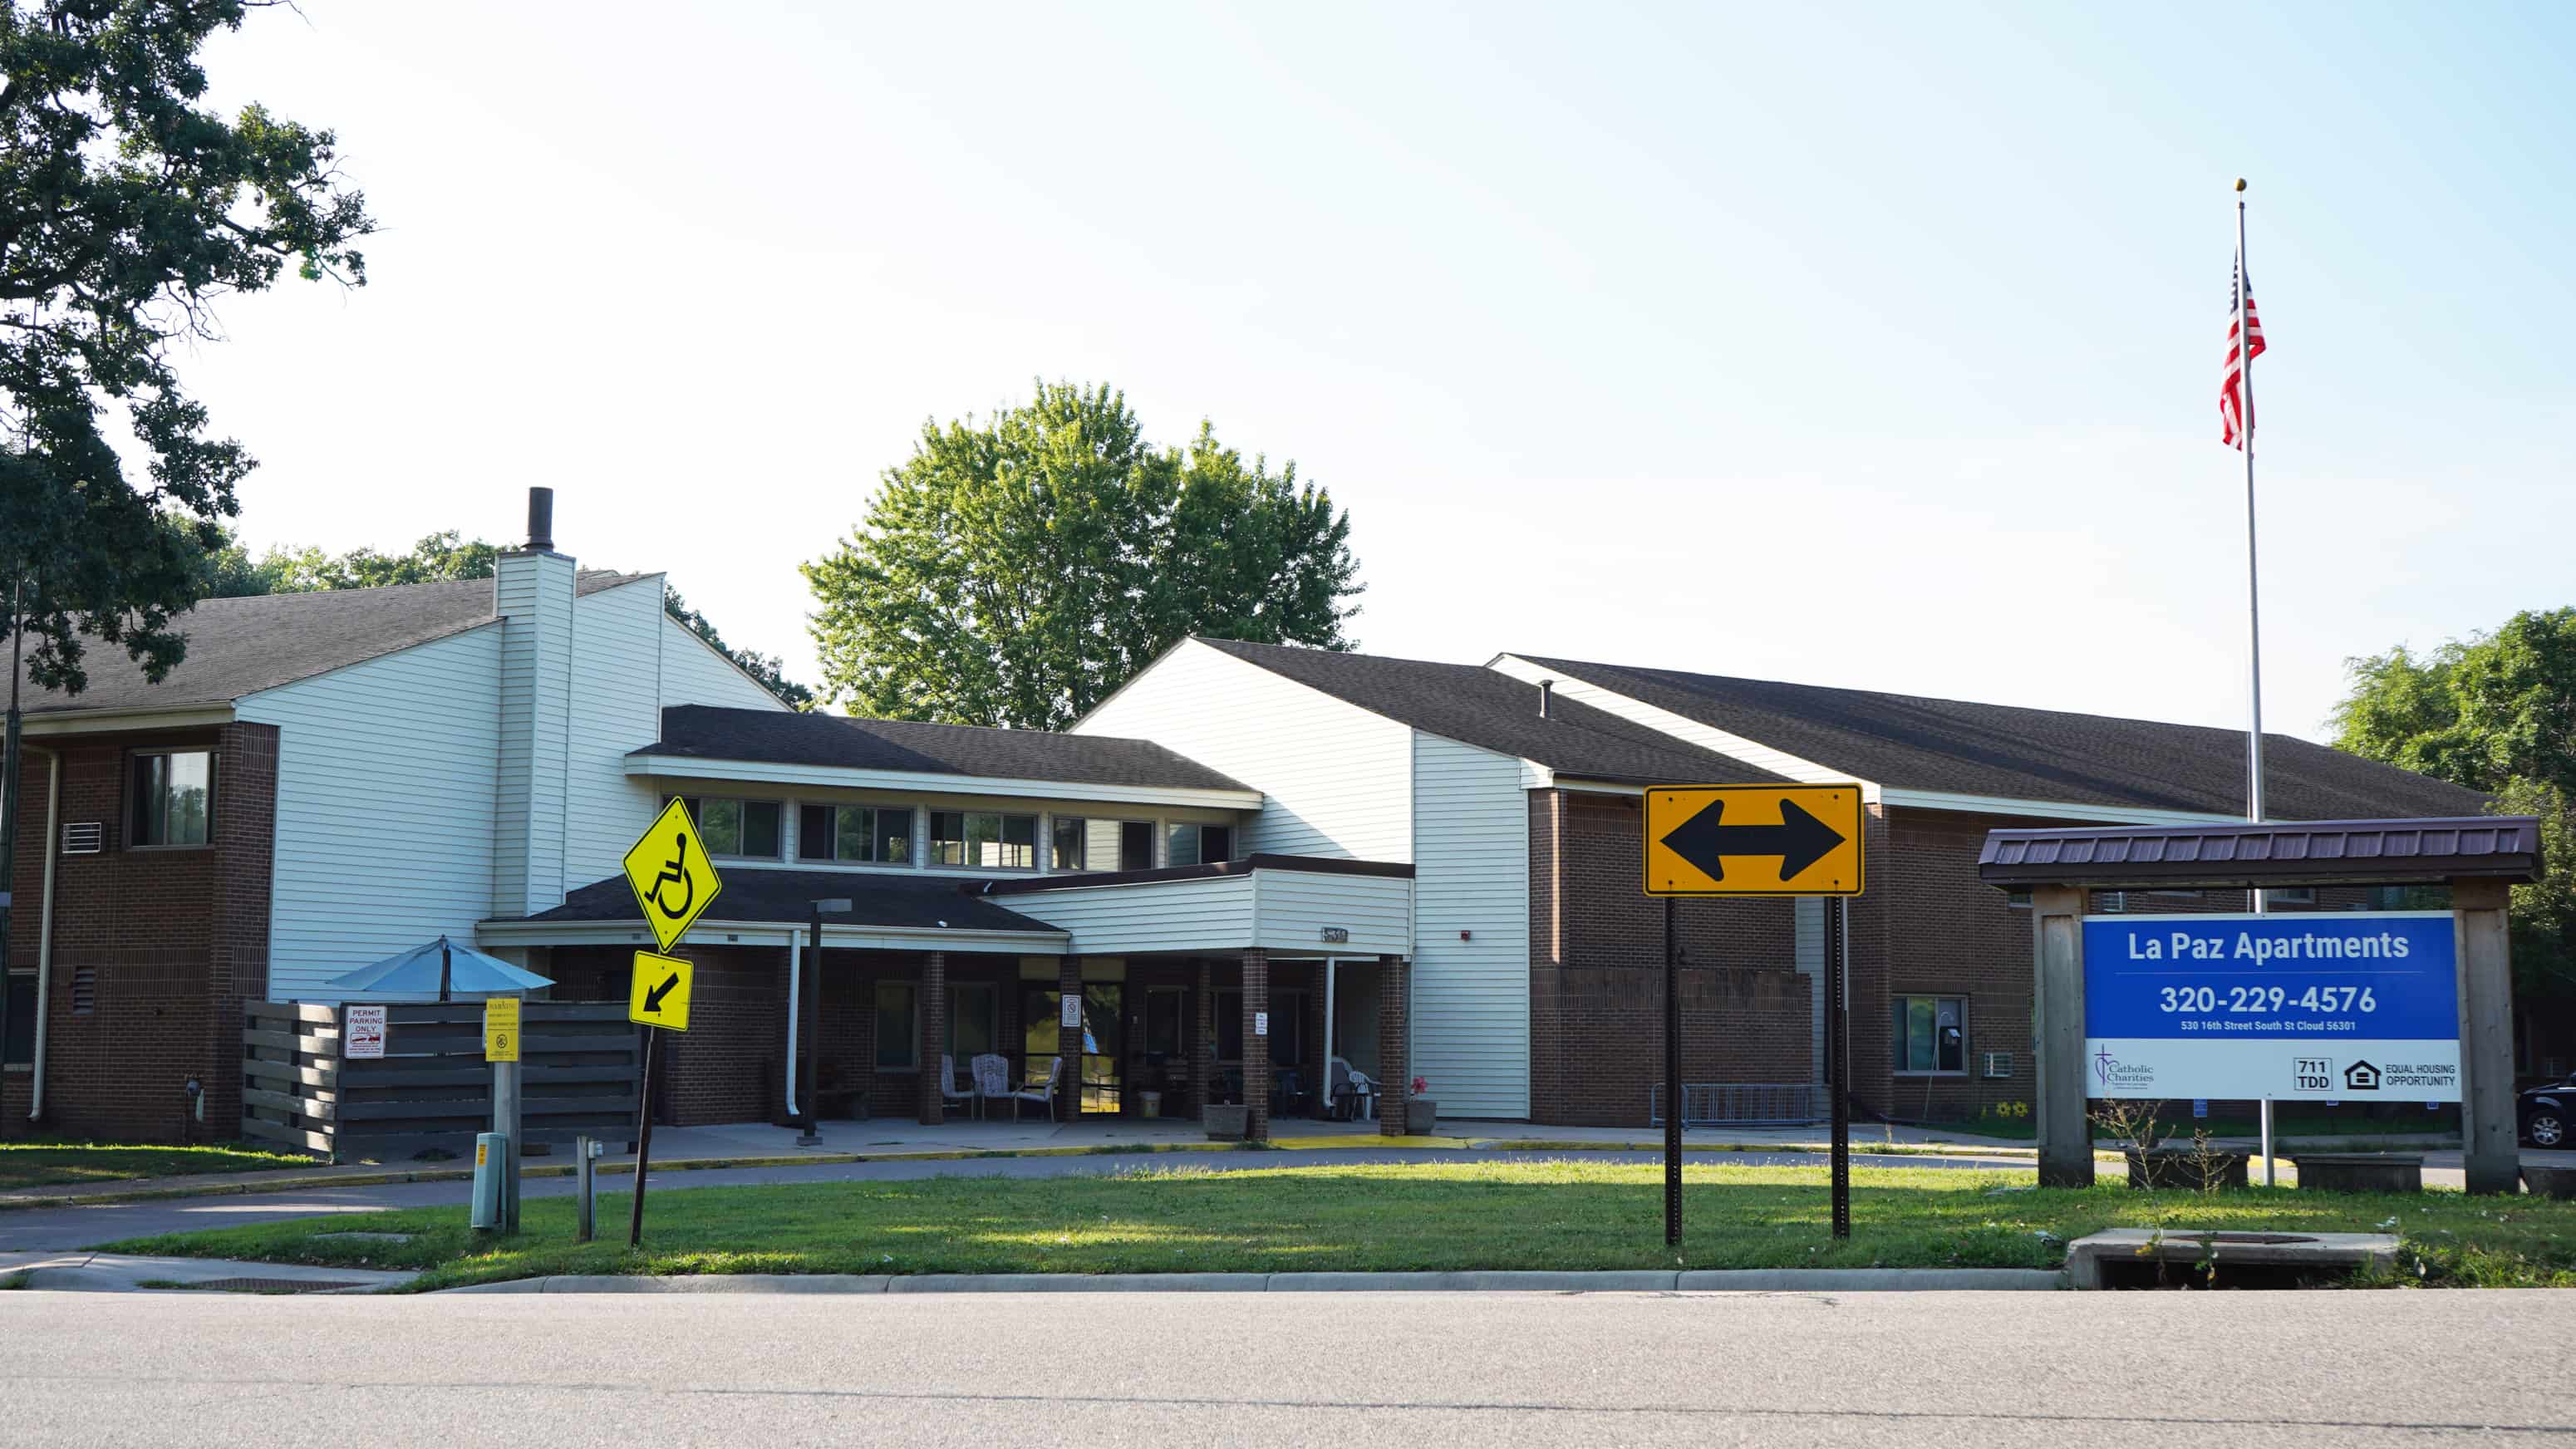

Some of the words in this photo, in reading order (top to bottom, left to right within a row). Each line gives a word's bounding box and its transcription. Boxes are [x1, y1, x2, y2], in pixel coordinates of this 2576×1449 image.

[2128, 932, 2162, 960] La
[2170, 932, 2225, 960] Paz
[2233, 931, 2410, 966] Apartments
[2160, 986, 2377, 1013] 320-229-4576
[2180, 1020, 2199, 1031] 530
[2202, 1020, 2222, 1031] 16th
[2224, 1020, 2253, 1031] Street
[2254, 1020, 2282, 1031] South
[2284, 1020, 2295, 1031] St
[2297, 1020, 2324, 1031] Cloud
[2326, 1020, 2357, 1031] 56301
[2108, 1064, 2154, 1073] Catholic
[2298, 1060, 2326, 1073] 711
[2386, 1063, 2415, 1075] EQUAL
[2416, 1063, 2456, 1075] HOUSING
[2107, 1073, 2155, 1083] Charities
[2297, 1076, 2329, 1088] TDD
[2386, 1075, 2456, 1086] OPPORTUNITY
